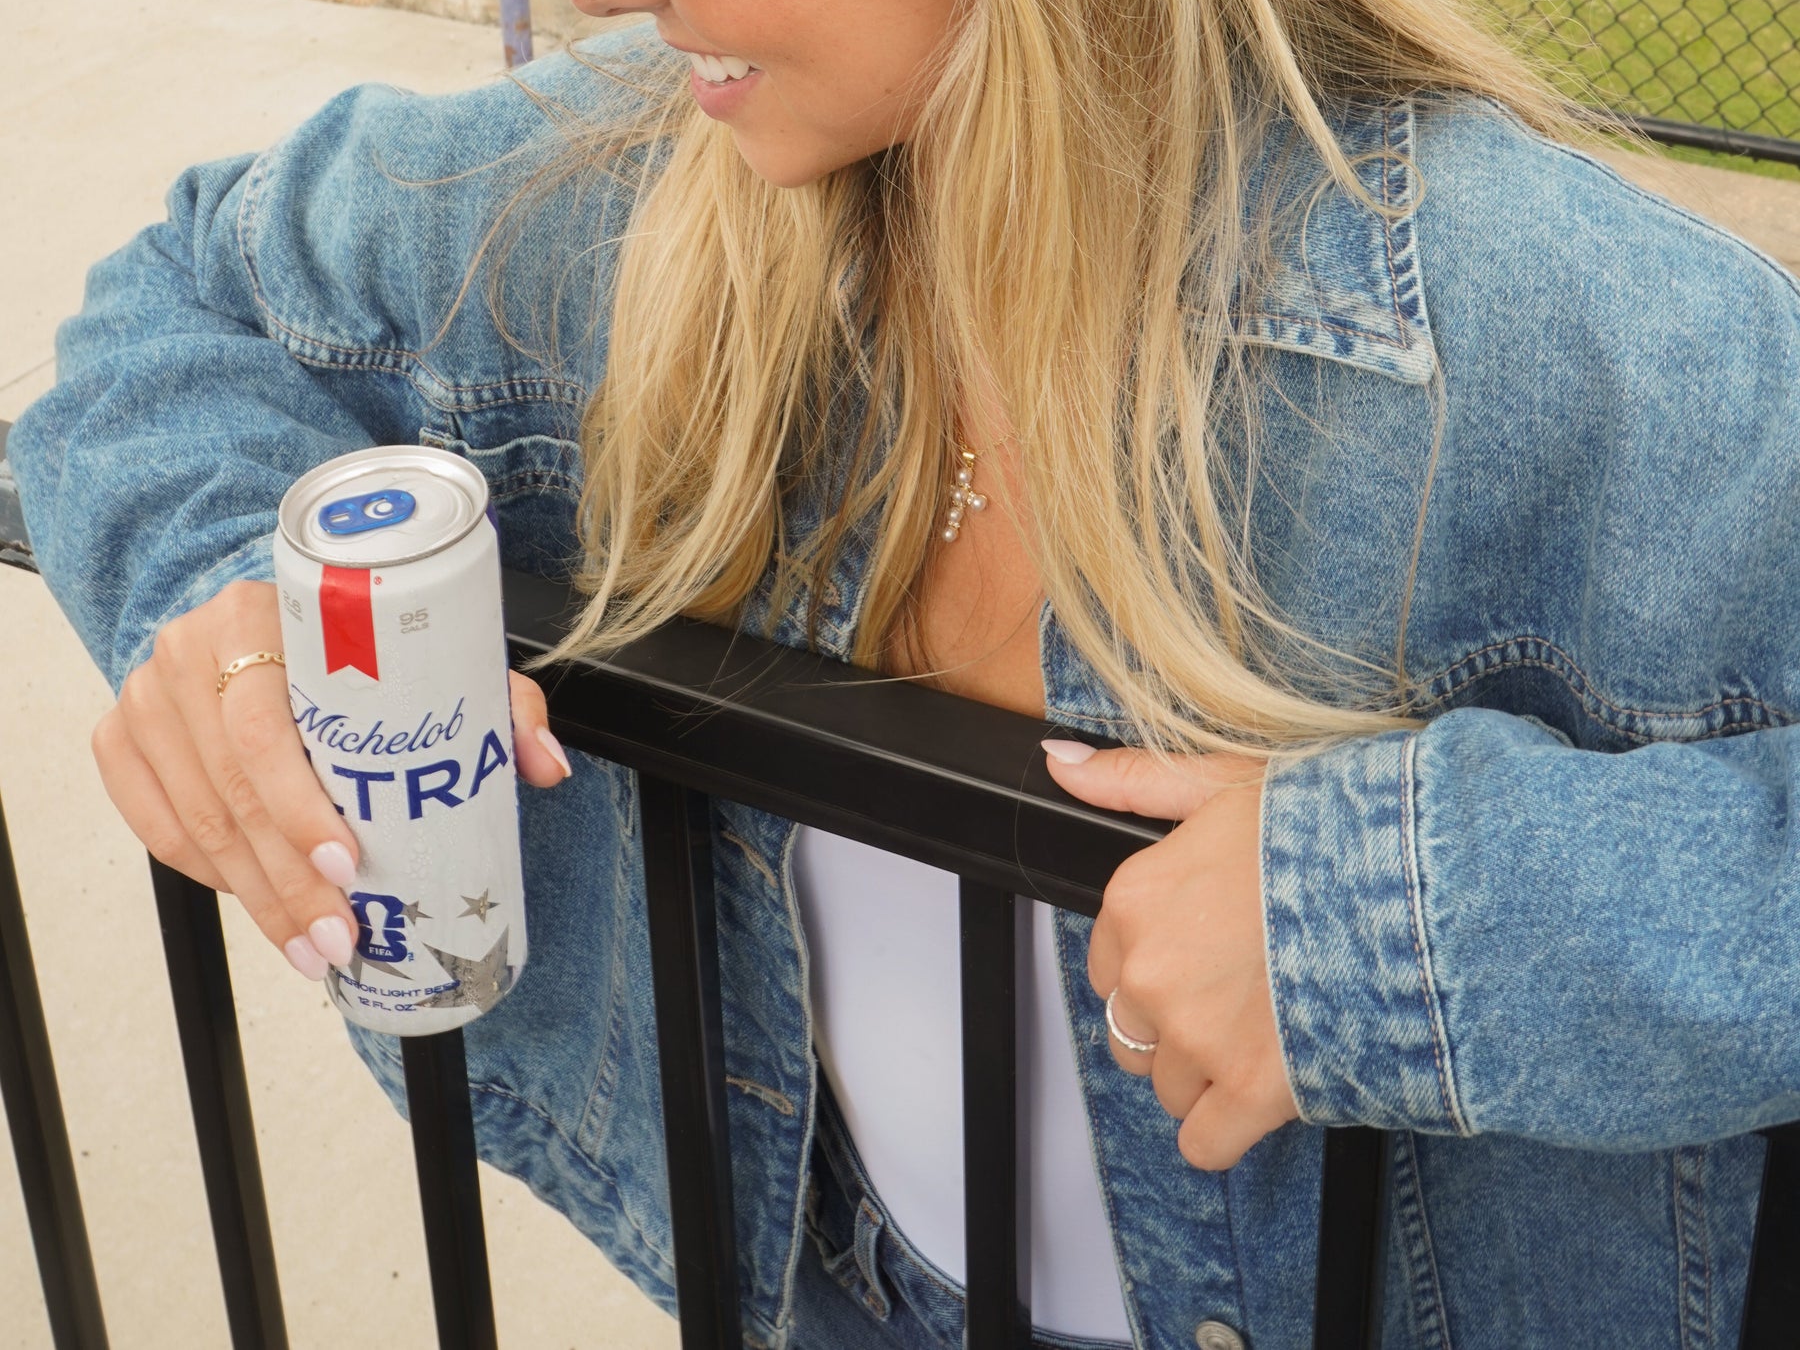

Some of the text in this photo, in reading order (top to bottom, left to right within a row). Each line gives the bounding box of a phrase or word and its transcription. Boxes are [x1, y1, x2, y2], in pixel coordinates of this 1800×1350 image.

[399, 607, 429, 626] 95
[400, 621, 430, 635] CALS
[290, 683, 465, 756] Michelob
[368, 946, 394, 957] FIFA
[380, 988, 421, 998] LIGHT
